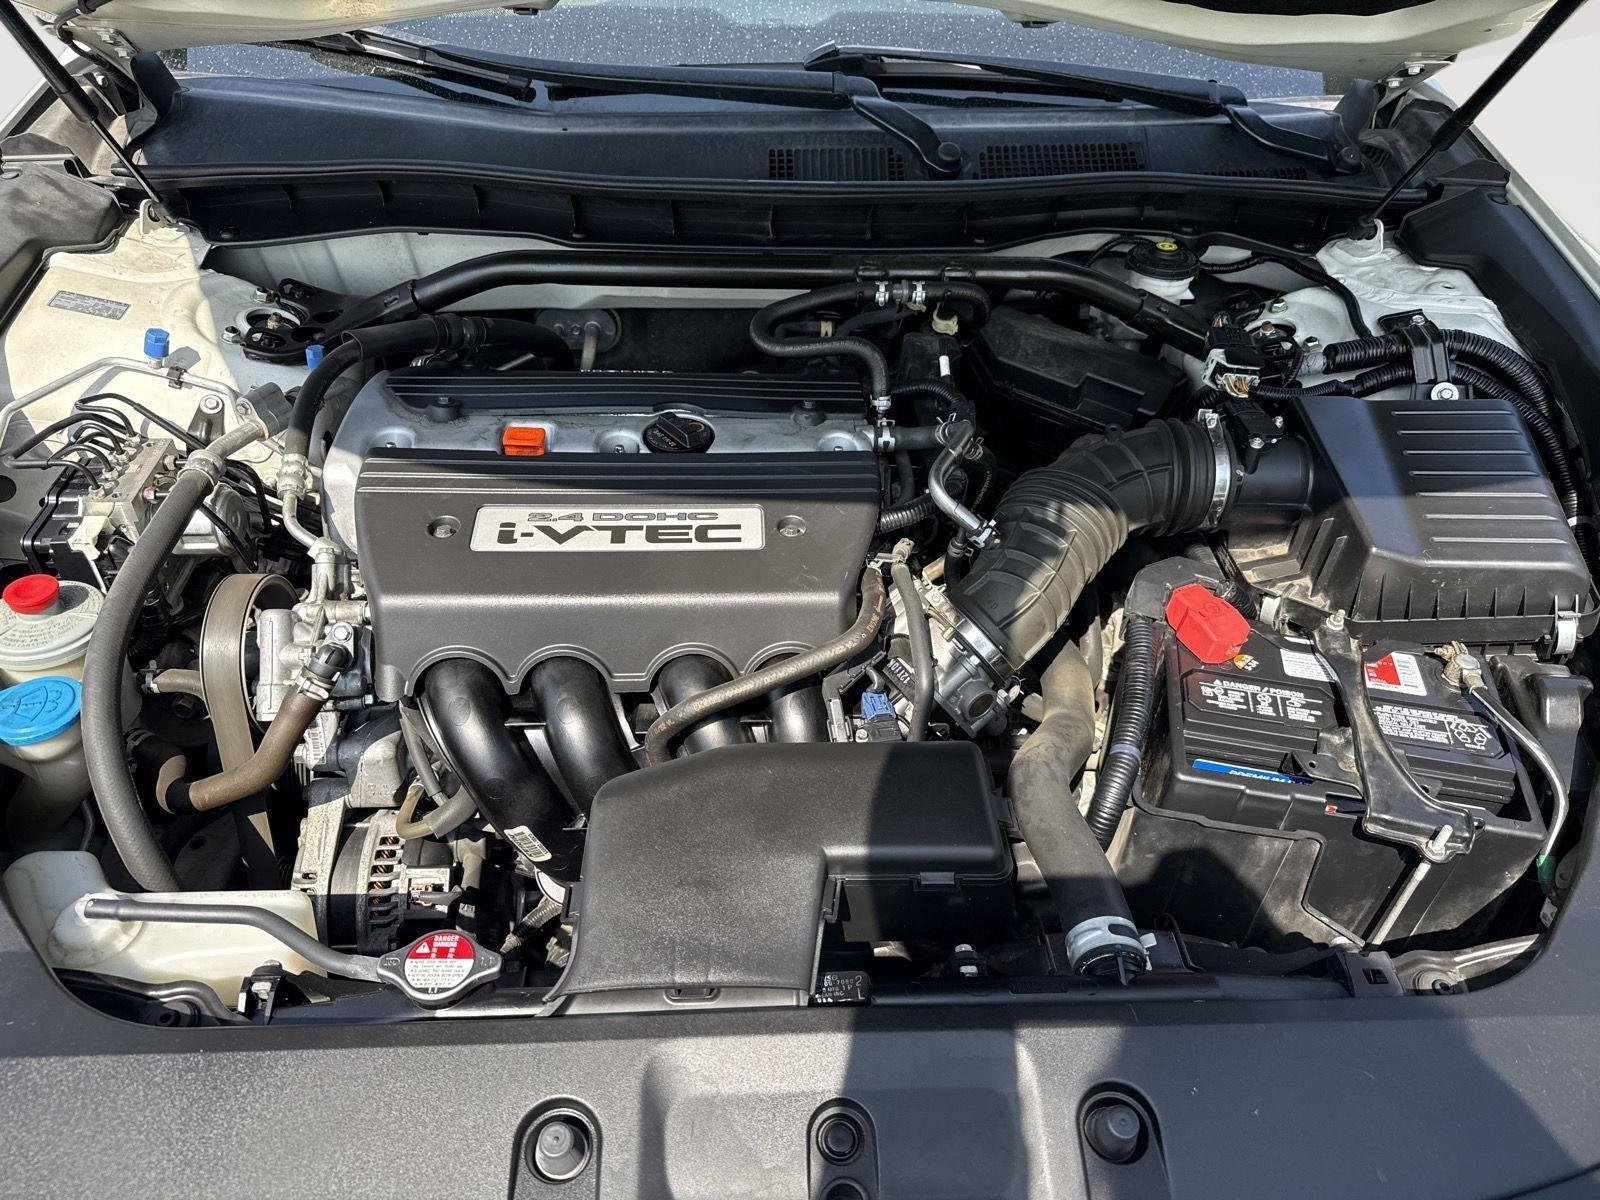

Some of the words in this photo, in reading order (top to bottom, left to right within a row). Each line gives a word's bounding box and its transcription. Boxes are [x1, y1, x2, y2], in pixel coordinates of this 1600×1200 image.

[528, 512, 584, 522] 2.4
[592, 512, 719, 522] DOHC
[497, 521, 742, 545] i-VTEC
[1222, 680, 1261, 692] DANGER
[1269, 687, 1305, 699] POISON
